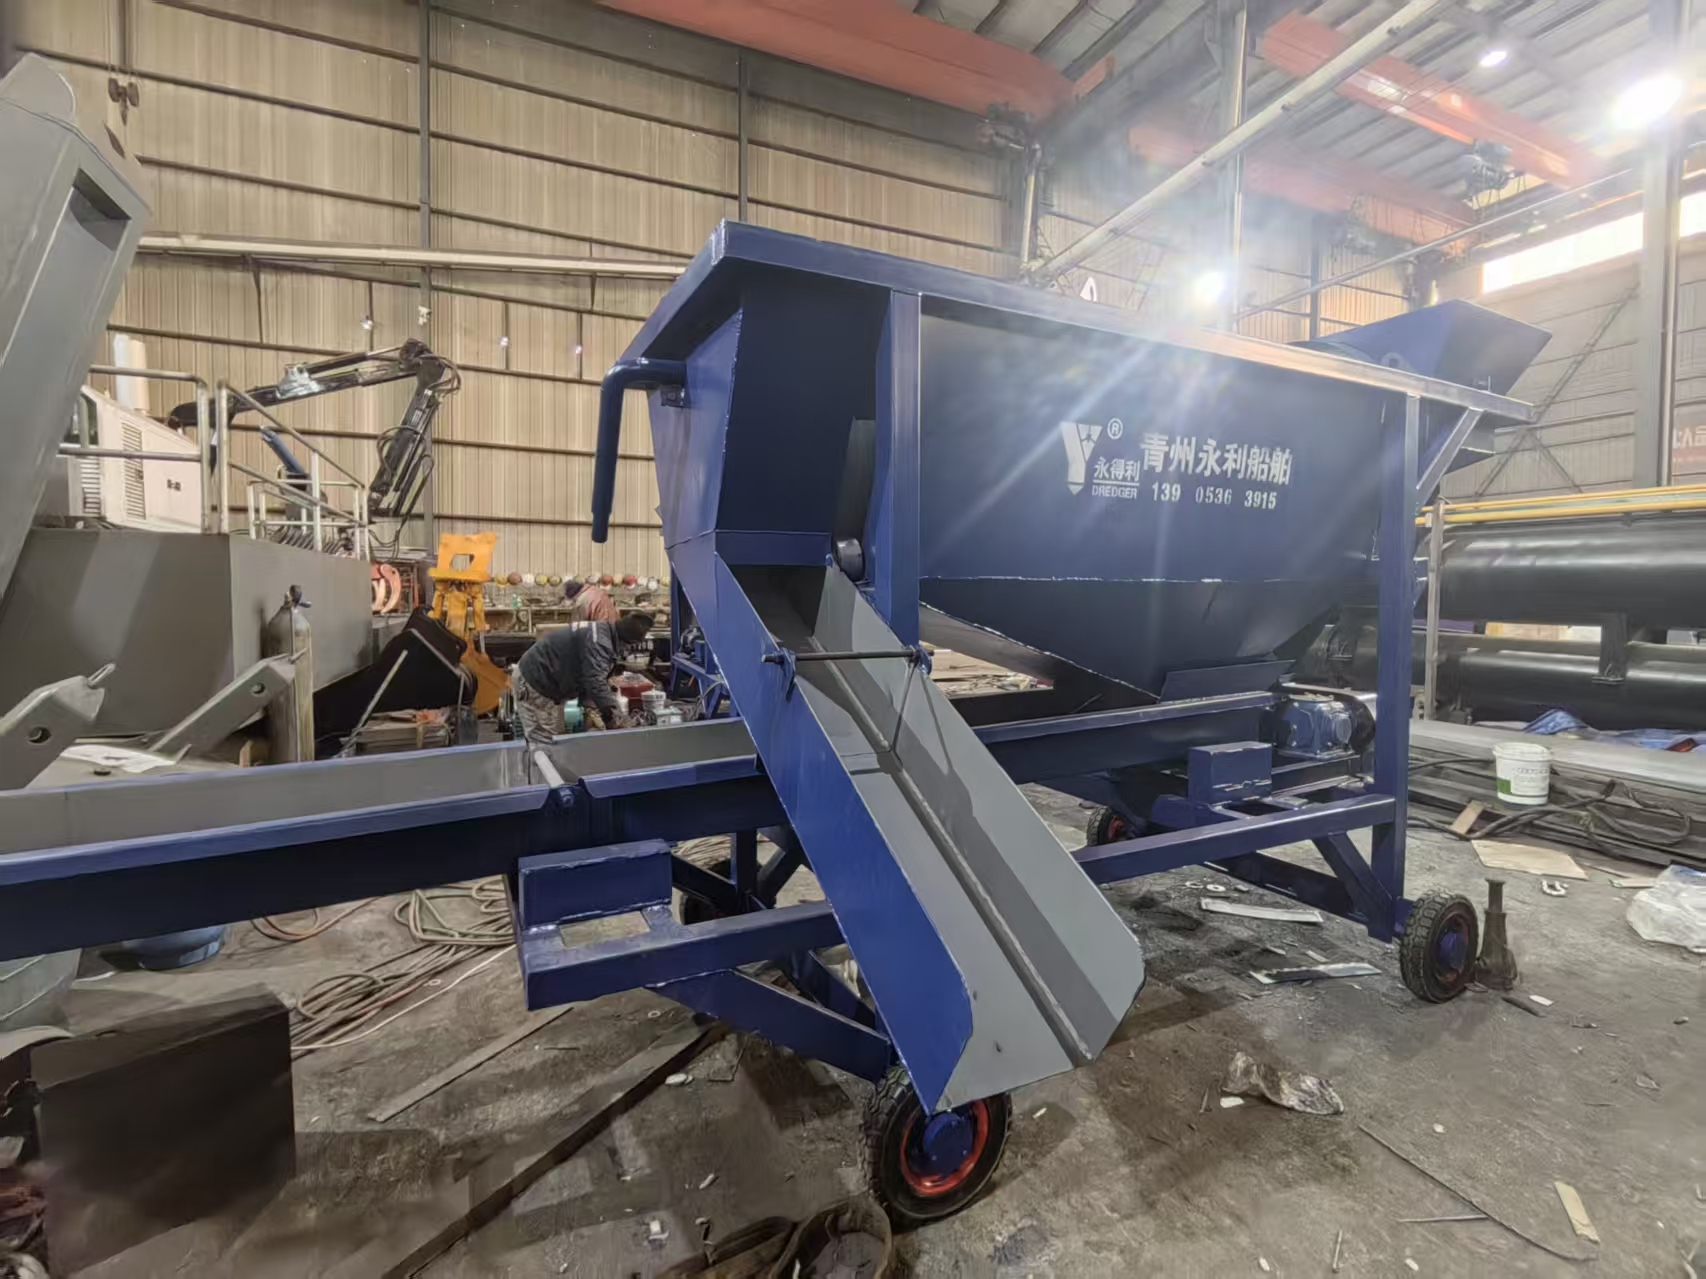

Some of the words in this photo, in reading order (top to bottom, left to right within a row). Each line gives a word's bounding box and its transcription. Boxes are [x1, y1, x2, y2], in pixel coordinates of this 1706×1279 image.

[1094, 456, 1140, 481] 永得利
[1140, 432, 1293, 485] 青州永利船舶
[1091, 484, 1137, 499] DREDGER
[1152, 482, 1181, 502] 139
[1195, 486, 1232, 505] 0536
[1244, 490, 1277, 510] 3915
